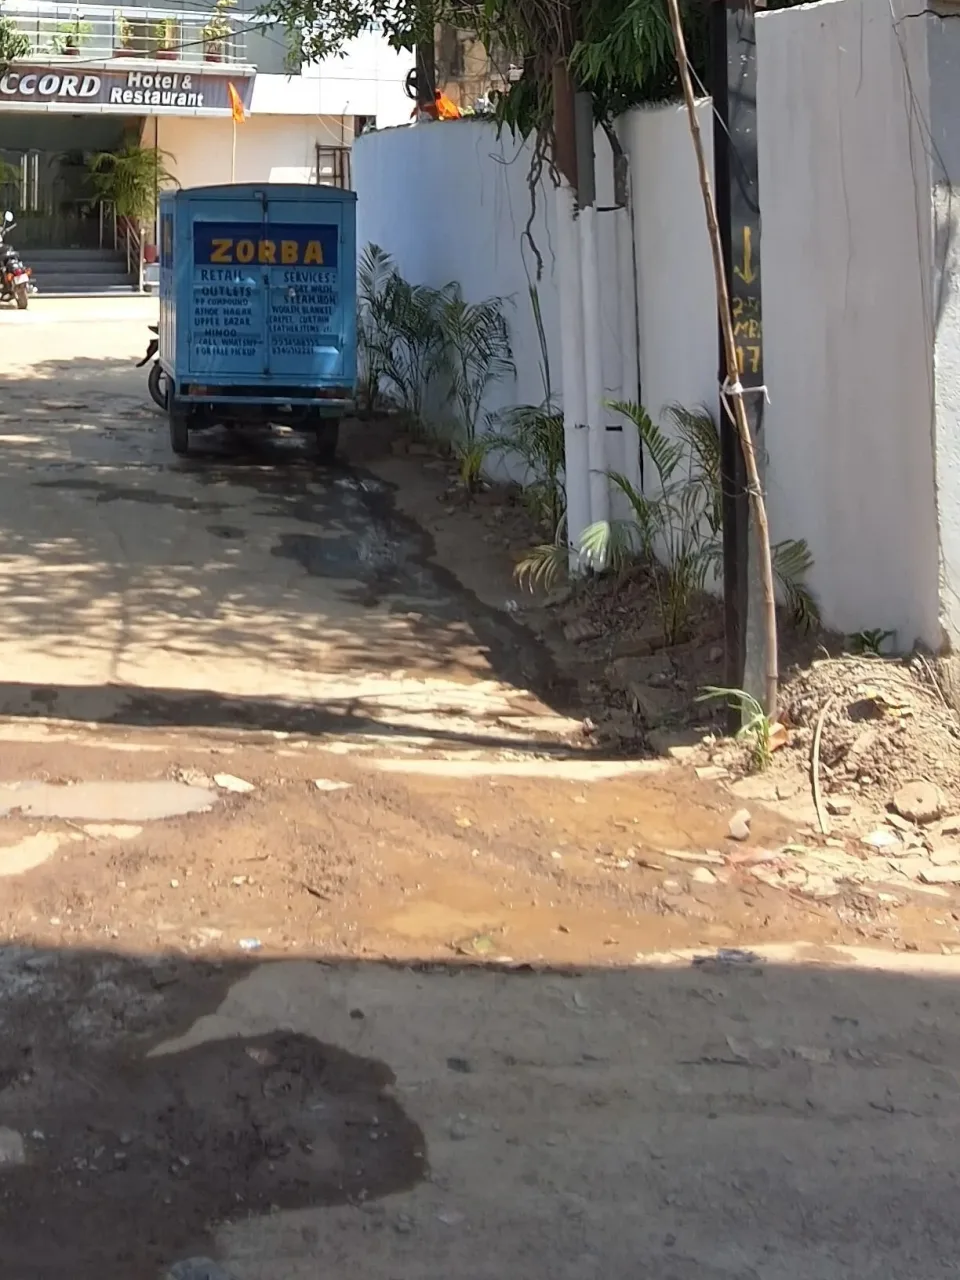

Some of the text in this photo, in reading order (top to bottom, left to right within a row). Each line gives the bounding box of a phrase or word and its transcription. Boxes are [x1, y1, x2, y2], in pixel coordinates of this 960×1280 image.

[127, 71, 192, 90] Hotel &
[110, 87, 204, 107] Restaurant
[210, 238, 324, 265] ZORBA
[201, 269, 245, 282] RETAIL
[201, 286, 252, 297] OUTLETS
